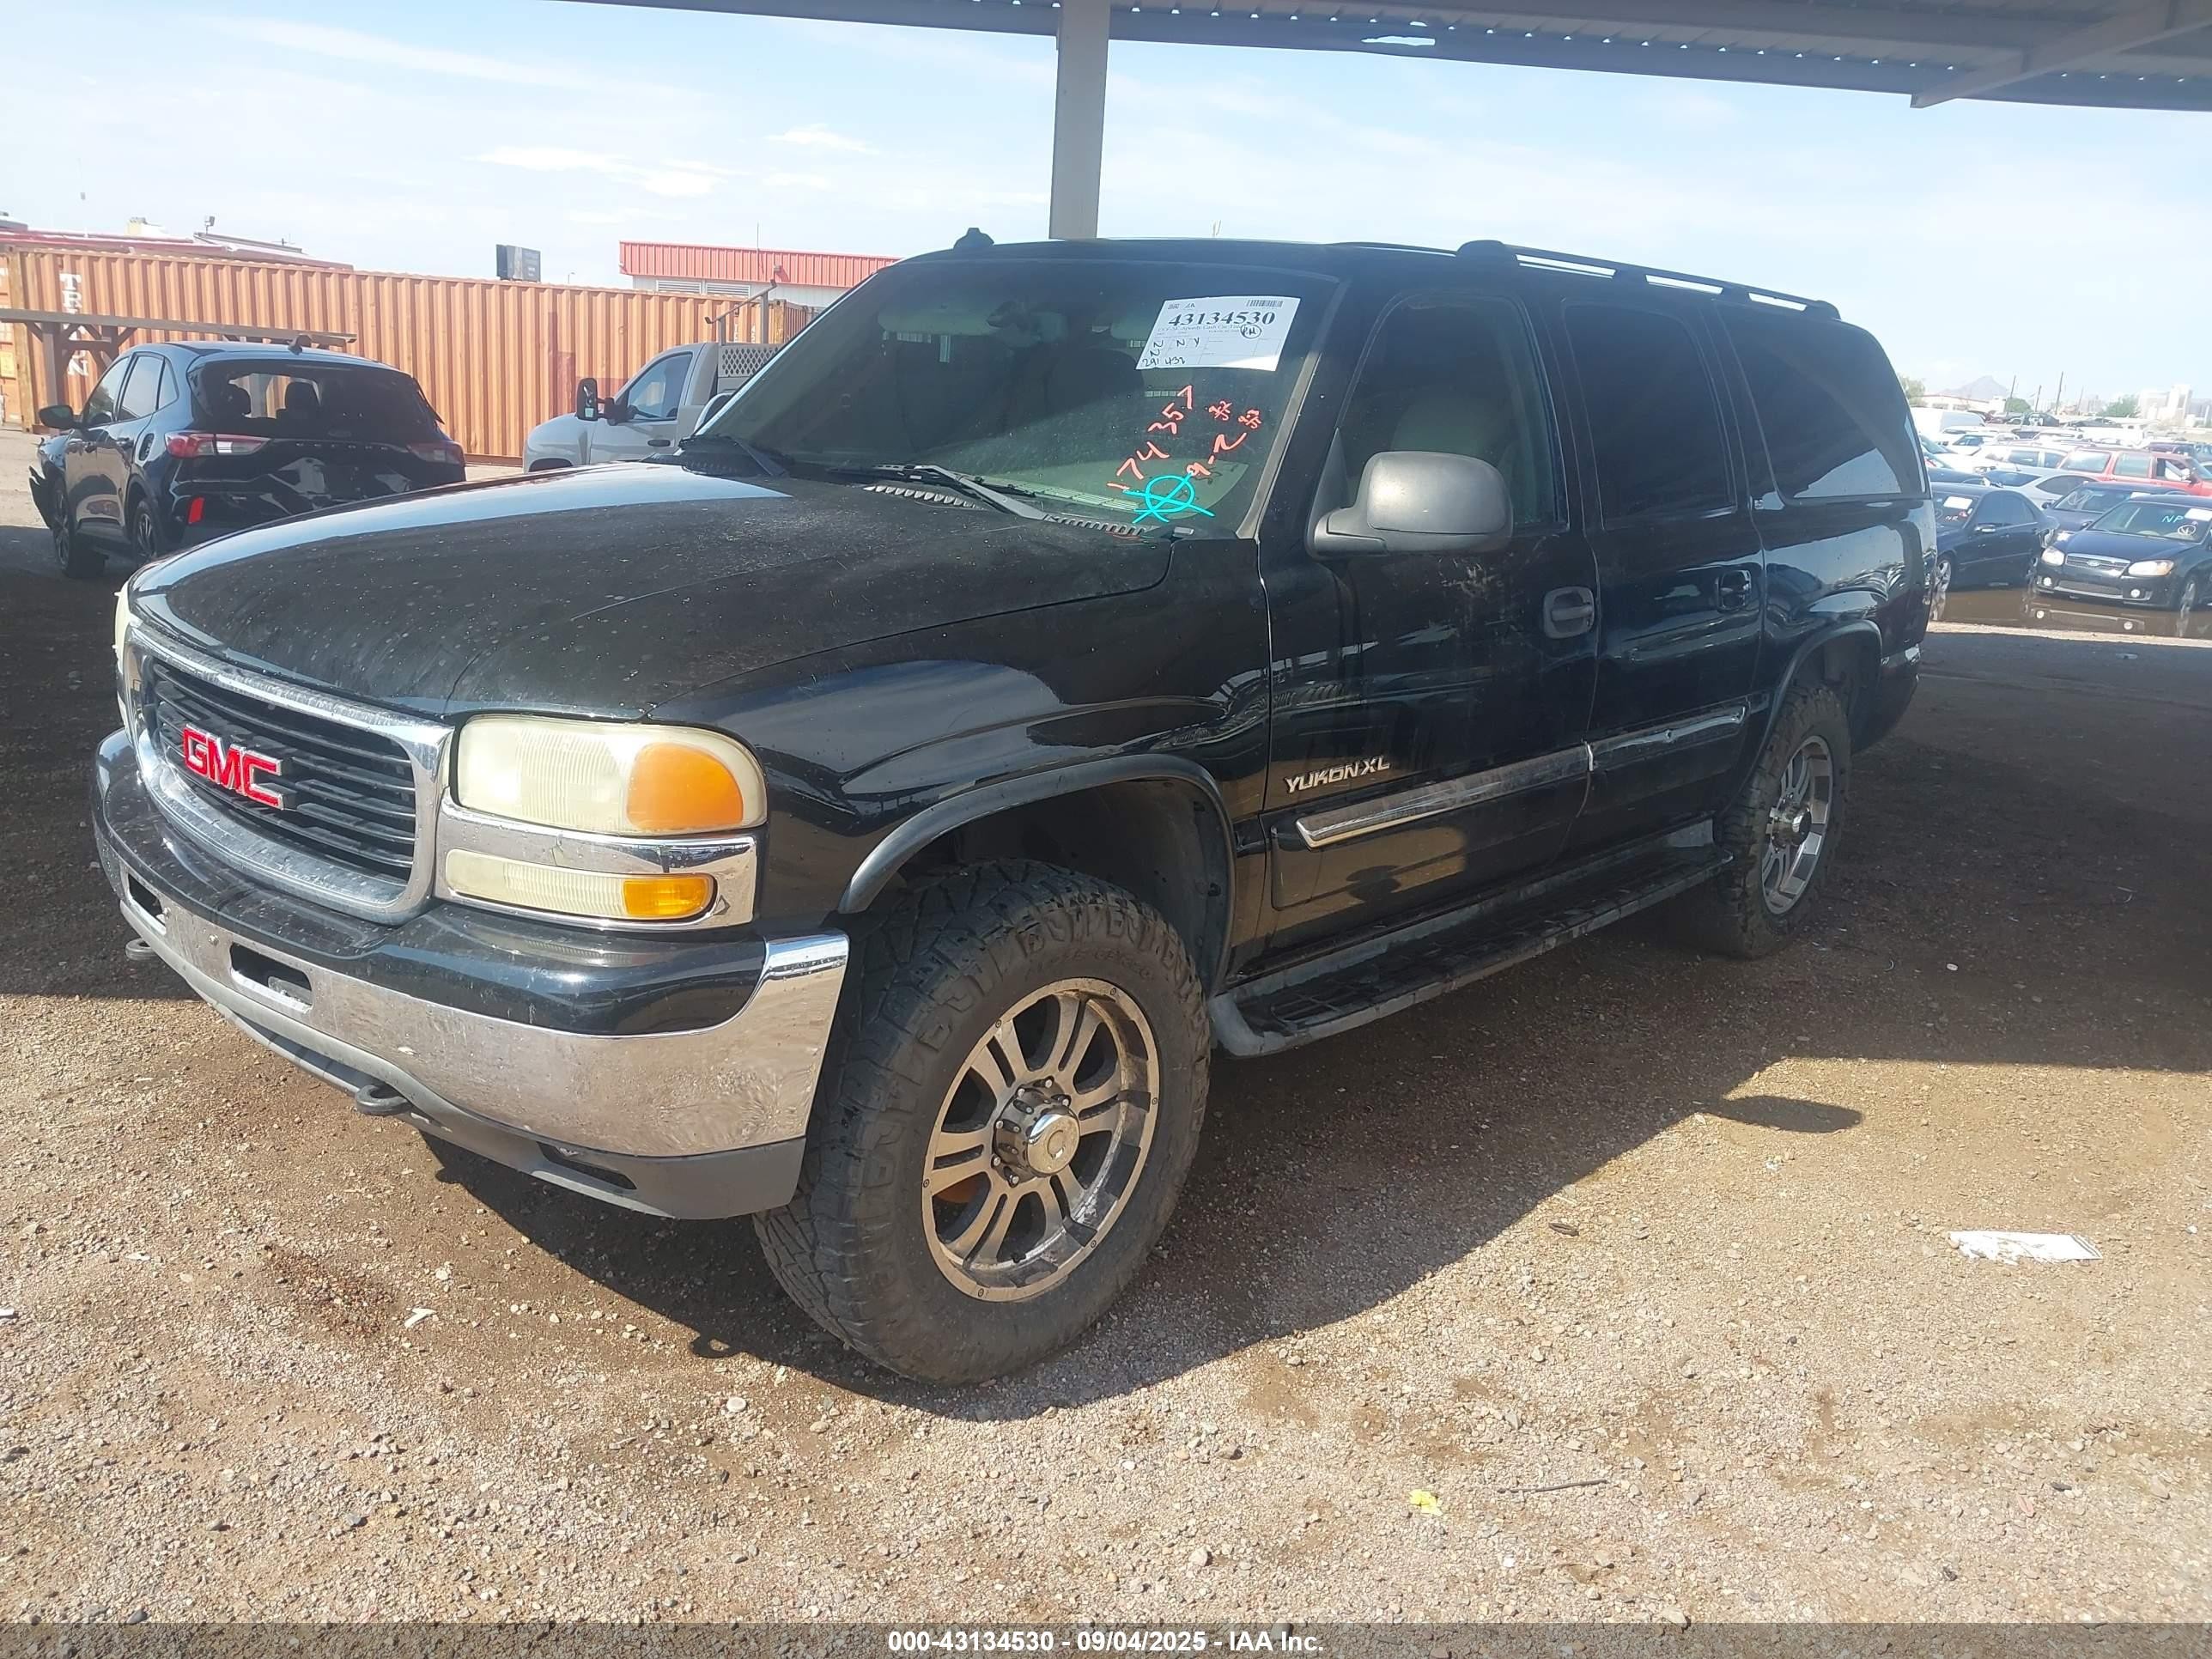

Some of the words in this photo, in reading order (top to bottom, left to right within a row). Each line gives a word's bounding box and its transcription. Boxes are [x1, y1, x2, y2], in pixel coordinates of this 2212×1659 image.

[1169, 311, 1275, 325] 43134530
[183, 723, 284, 811] GMC
[1285, 761, 1359, 793] YUKON
[1359, 756, 1390, 776] XL
